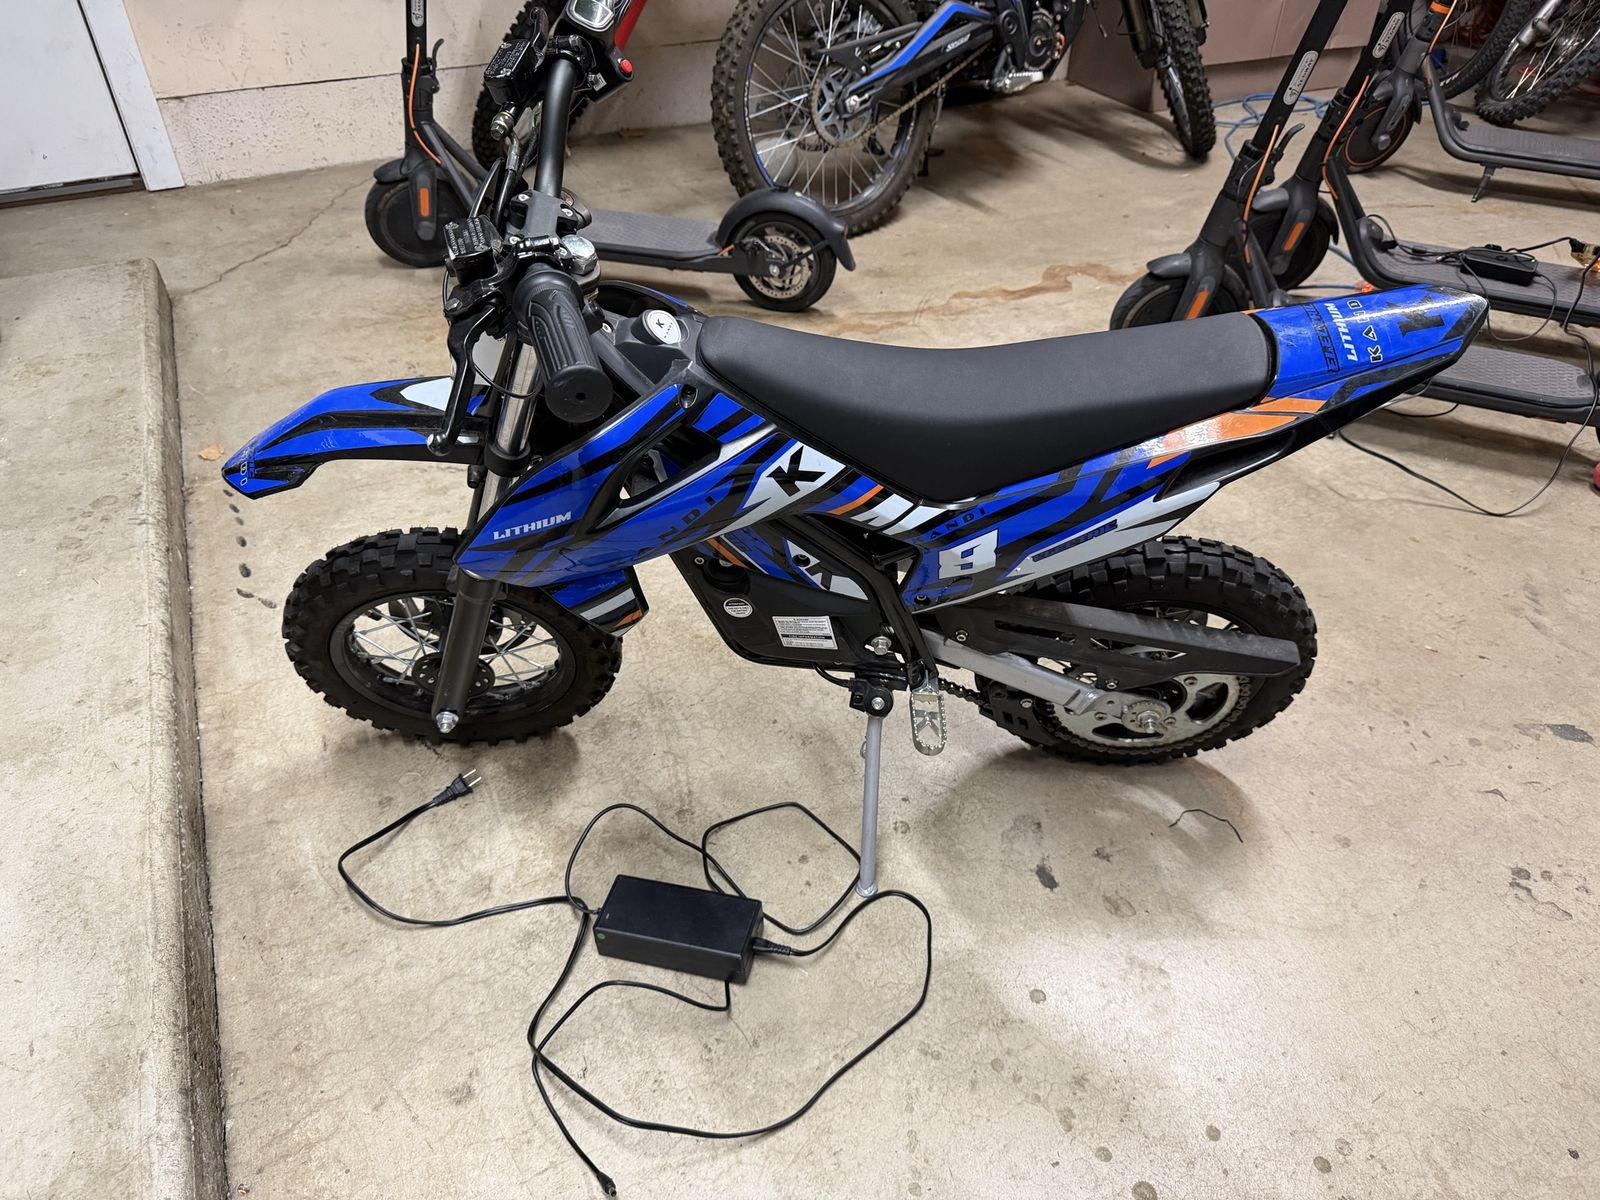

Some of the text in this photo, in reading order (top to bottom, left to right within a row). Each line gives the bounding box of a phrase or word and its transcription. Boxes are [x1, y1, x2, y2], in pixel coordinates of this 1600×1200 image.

[1324, 303, 1358, 361] LITHIUM
[766, 445, 827, 497] K
[493, 511, 572, 540] LITHIUM
[939, 528, 999, 579] 8
